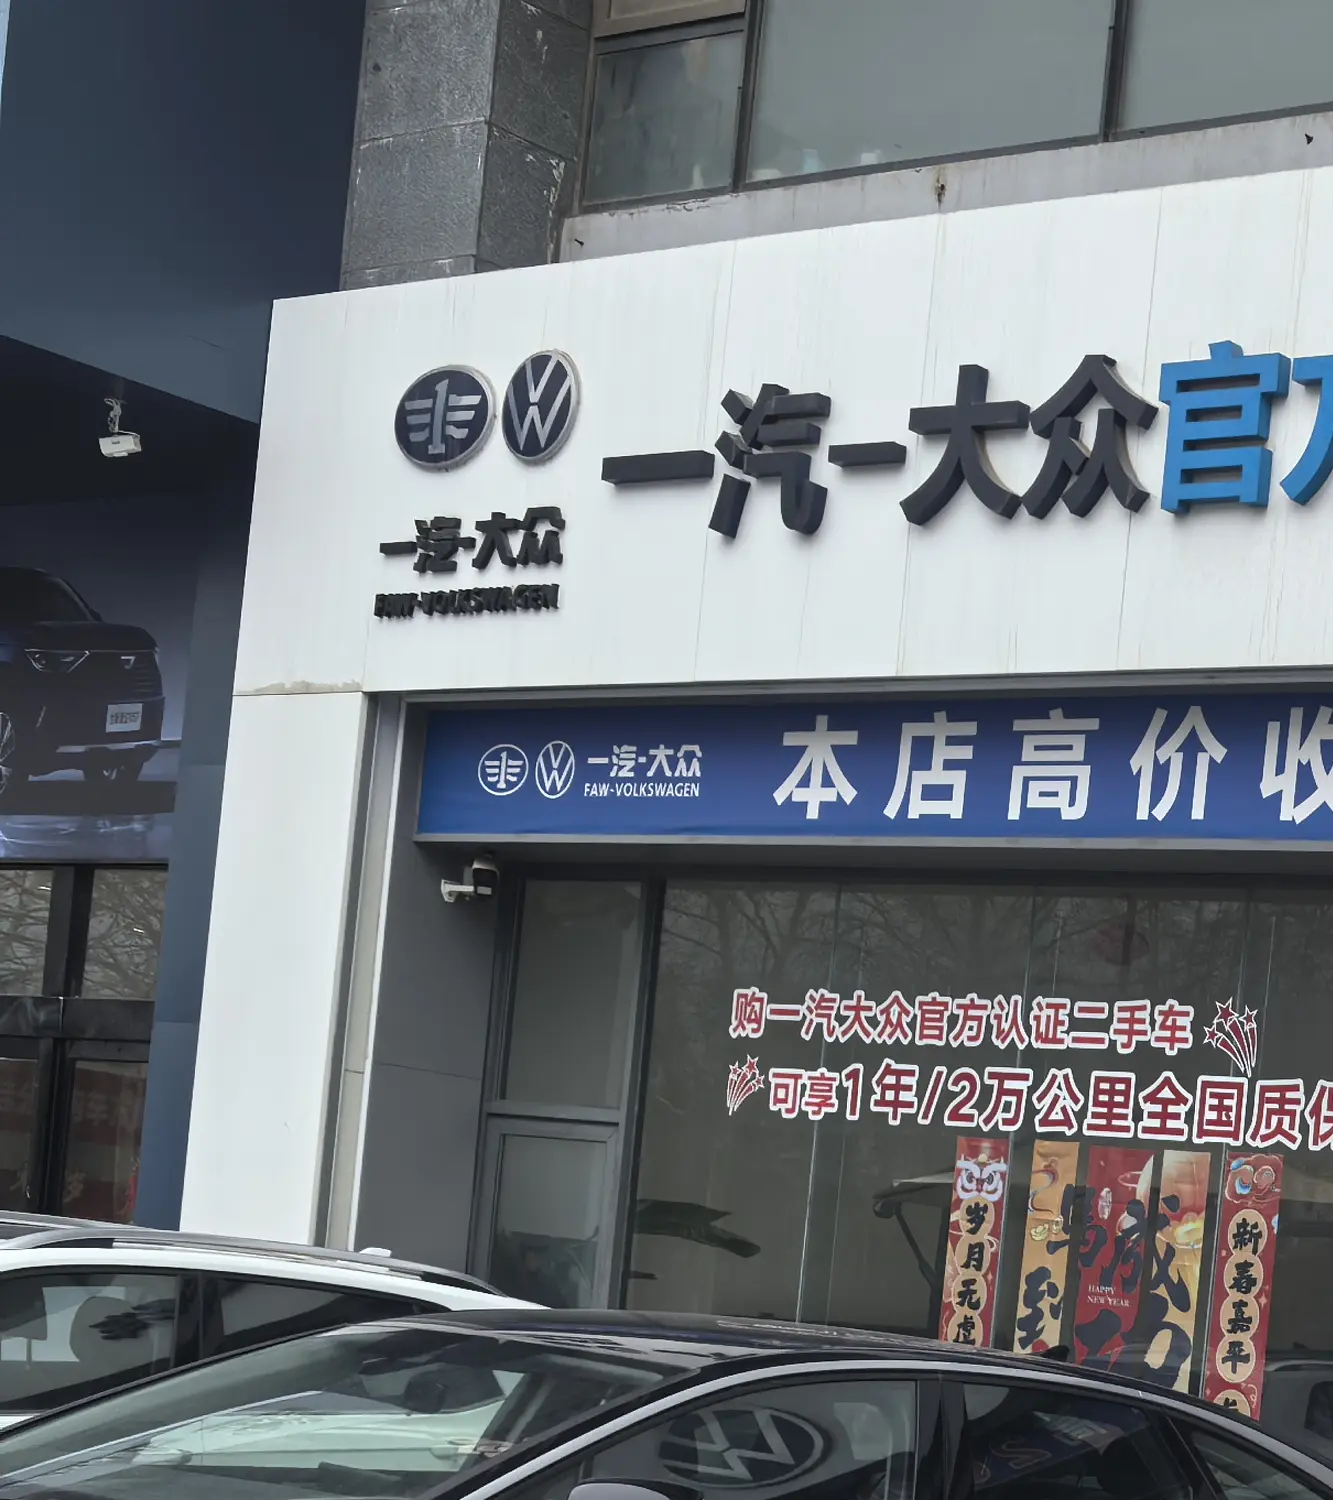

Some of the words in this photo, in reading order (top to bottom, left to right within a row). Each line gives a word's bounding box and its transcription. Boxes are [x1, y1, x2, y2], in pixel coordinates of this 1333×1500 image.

[379, 505, 566, 574] 一汽-大众
[587, 744, 703, 778] 一汽-大众
[583, 782, 700, 798] FAW-VOLKSWAGEN
[729, 987, 1195, 1054] 购一汽大众官方认证二手车
